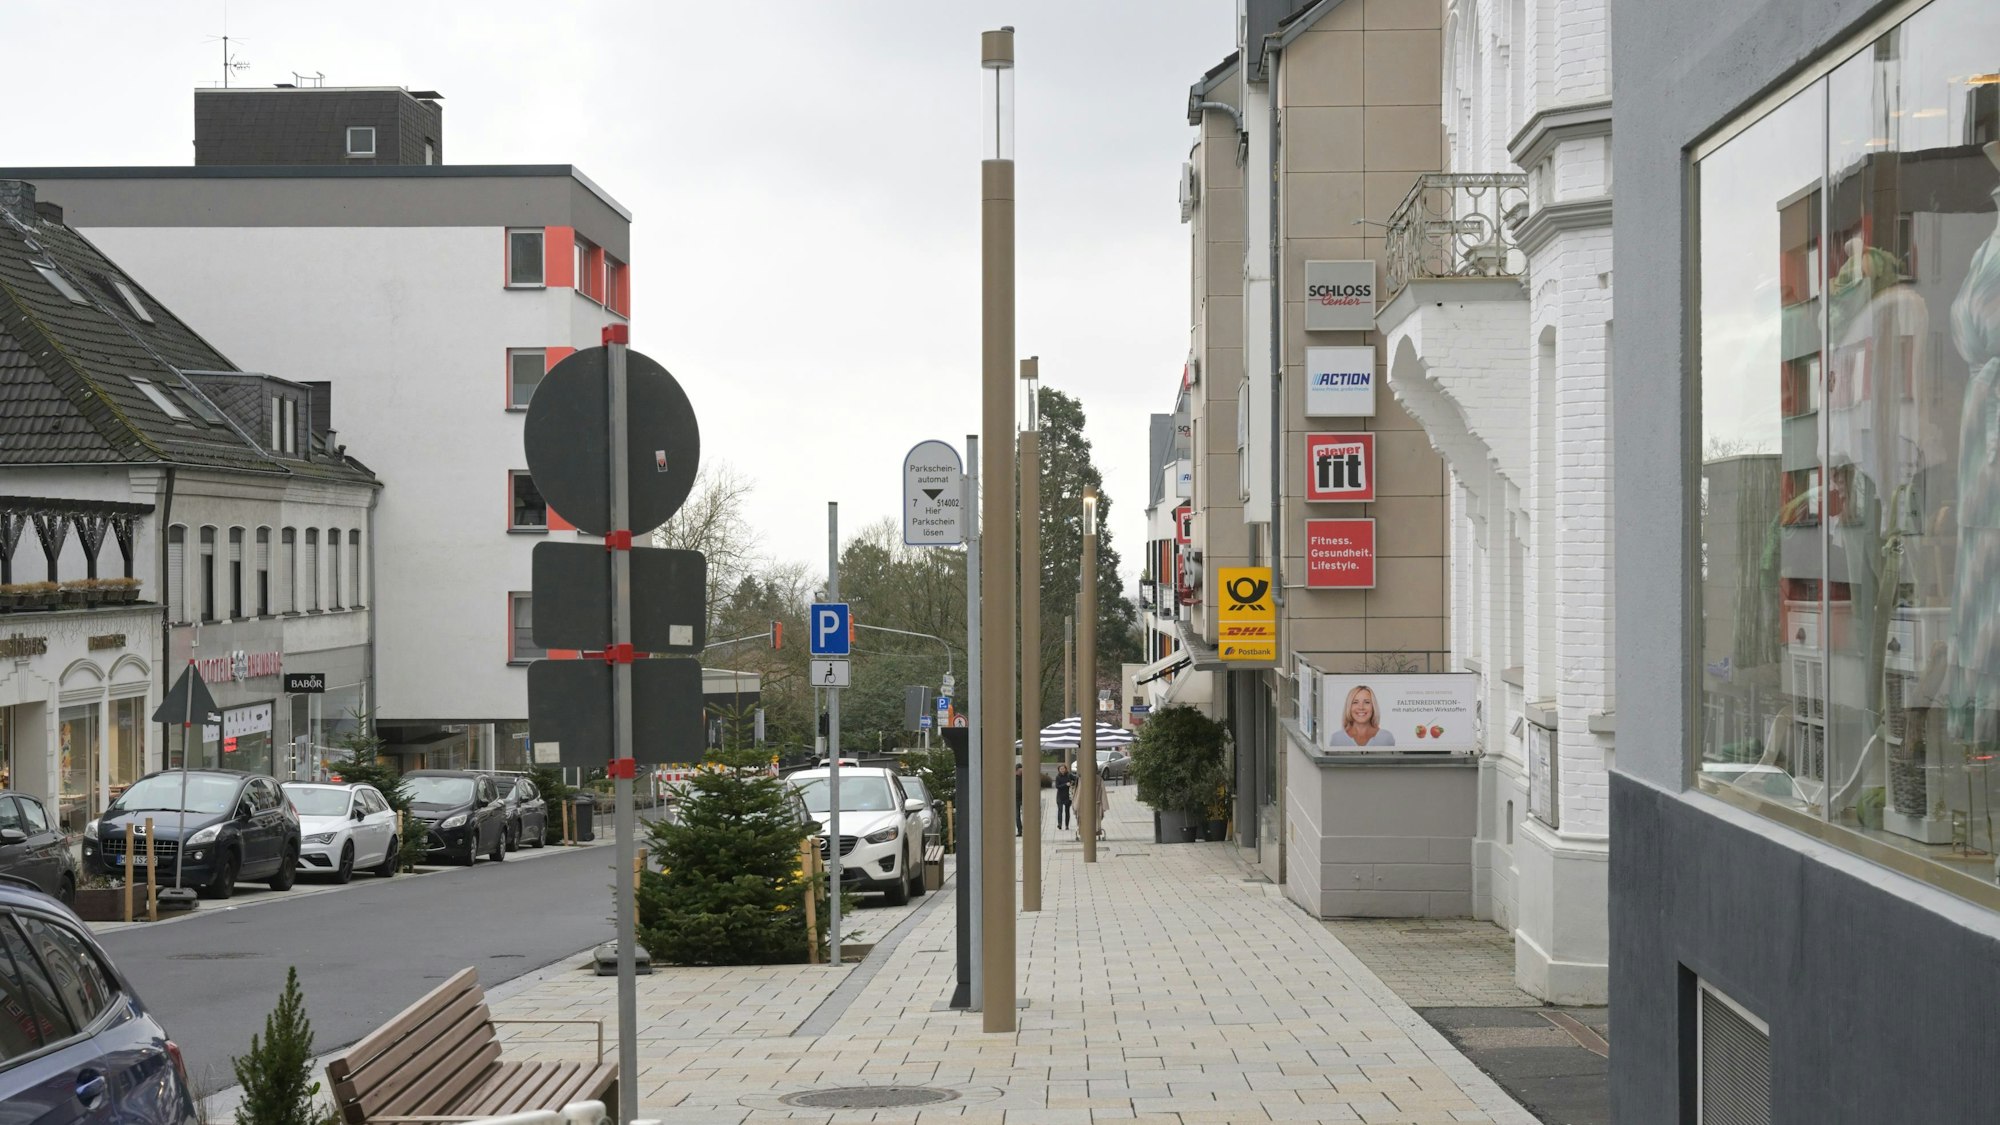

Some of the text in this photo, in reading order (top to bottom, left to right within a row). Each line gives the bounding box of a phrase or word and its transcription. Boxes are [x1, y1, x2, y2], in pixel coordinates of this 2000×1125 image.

[1309, 285, 1371, 297] SCHLOSS
[1321, 293, 1361, 306] Center
[1319, 373, 1371, 385] ACTION
[1316, 446, 1361, 457] clever
[910, 464, 956, 473] Parkschein-
[1316, 454, 1362, 488] fit
[912, 499, 960, 507] 7 514002
[925, 507, 942, 515] Hier
[912, 517, 955, 526] Parkschein
[1311, 536, 1353, 545] Fitness.
[1311, 548, 1372, 558] Gesundheit.
[1311, 561, 1360, 571] Lifestyle.
[819, 610, 840, 648] P
[1227, 627, 1267, 636] DHL
[1238, 648, 1271, 656] Postbank
[291, 678, 323, 688] BABOR
[939, 698, 946, 709] P
